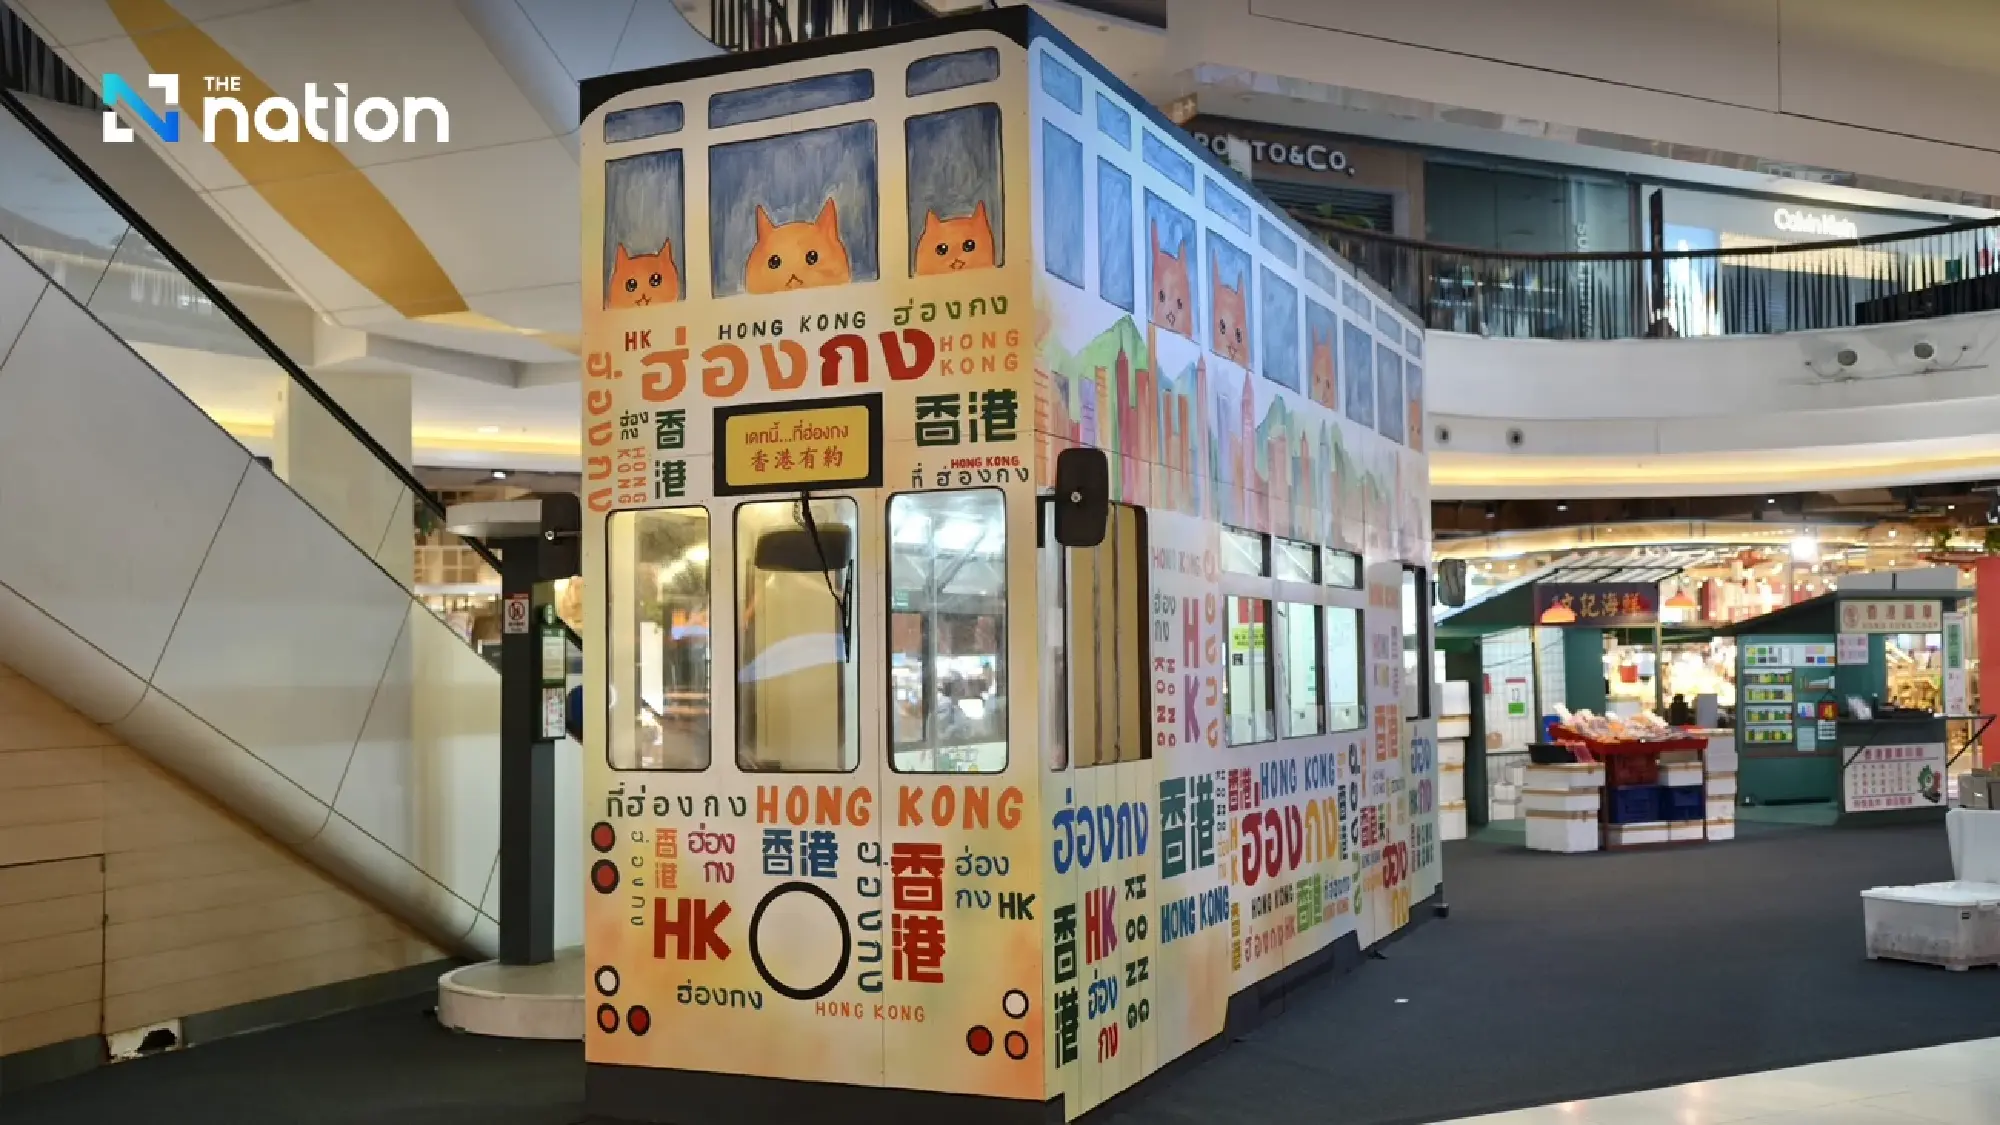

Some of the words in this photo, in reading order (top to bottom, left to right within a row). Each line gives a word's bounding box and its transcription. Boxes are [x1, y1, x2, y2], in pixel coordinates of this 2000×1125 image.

[718, 319, 784, 341] HONG
[799, 311, 867, 333] KONG
[893, 294, 1008, 326] ฮ่องกง
[624, 329, 652, 352] HK
[640, 325, 936, 403] ฮ่องกง
[939, 329, 1020, 353] HONG
[940, 353, 1020, 377] KONG
[586, 351, 622, 513] ฮ่องกง
[618, 408, 649, 429] ฮ่อง
[620, 426, 639, 441] กง
[915, 388, 1019, 447] 香港
[617, 447, 632, 505] KONG
[632, 447, 647, 504] HONG
[655, 407, 687, 500] 香港
[750, 444, 843, 473] 香港有約
[911, 463, 924, 489] ที่
[936, 464, 1030, 488] ฮ่องกง
[950, 457, 983, 470] HONG
[984, 455, 1020, 468] KONG
[1182, 596, 1200, 744] HK
[606, 781, 747, 818] ที่ฮ่องกง
[1228, 768, 1251, 812] 香港
[1260, 758, 1298, 801] HONG
[1304, 752, 1336, 792] KONG
[756, 785, 873, 828] HONG
[898, 785, 1025, 830] KONG
[1052, 787, 1149, 875] ฮ่องกง
[1159, 773, 1215, 881] 香港
[688, 822, 736, 855] ฮ่อง
[761, 829, 839, 880] 香港
[1242, 782, 1338, 887] ฮ่องกง
[654, 827, 678, 890] 香港
[703, 860, 735, 884] กง
[955, 845, 1010, 877] ฮ่อง
[857, 841, 890, 994] ฮ่องกง
[891, 842, 946, 984] 香港
[955, 887, 992, 910] กง
[997, 892, 1036, 922] HK
[1160, 897, 1196, 945] HONG
[1199, 885, 1230, 932] KONG
[1251, 892, 1272, 919] HONG
[1274, 882, 1293, 909] KONG
[654, 897, 732, 962] HK
[1085, 886, 1118, 965] HK
[1136, 873, 1149, 1023] HONG
[1124, 877, 1137, 1030] KONG
[676, 978, 764, 1010] ฮ่องกง
[1054, 903, 1079, 1069] 香港
[1087, 968, 1119, 1020] ฮ่อง
[815, 1001, 864, 1021] HONG
[873, 1003, 926, 1023] KONG
[1098, 1021, 1119, 1064] กง
